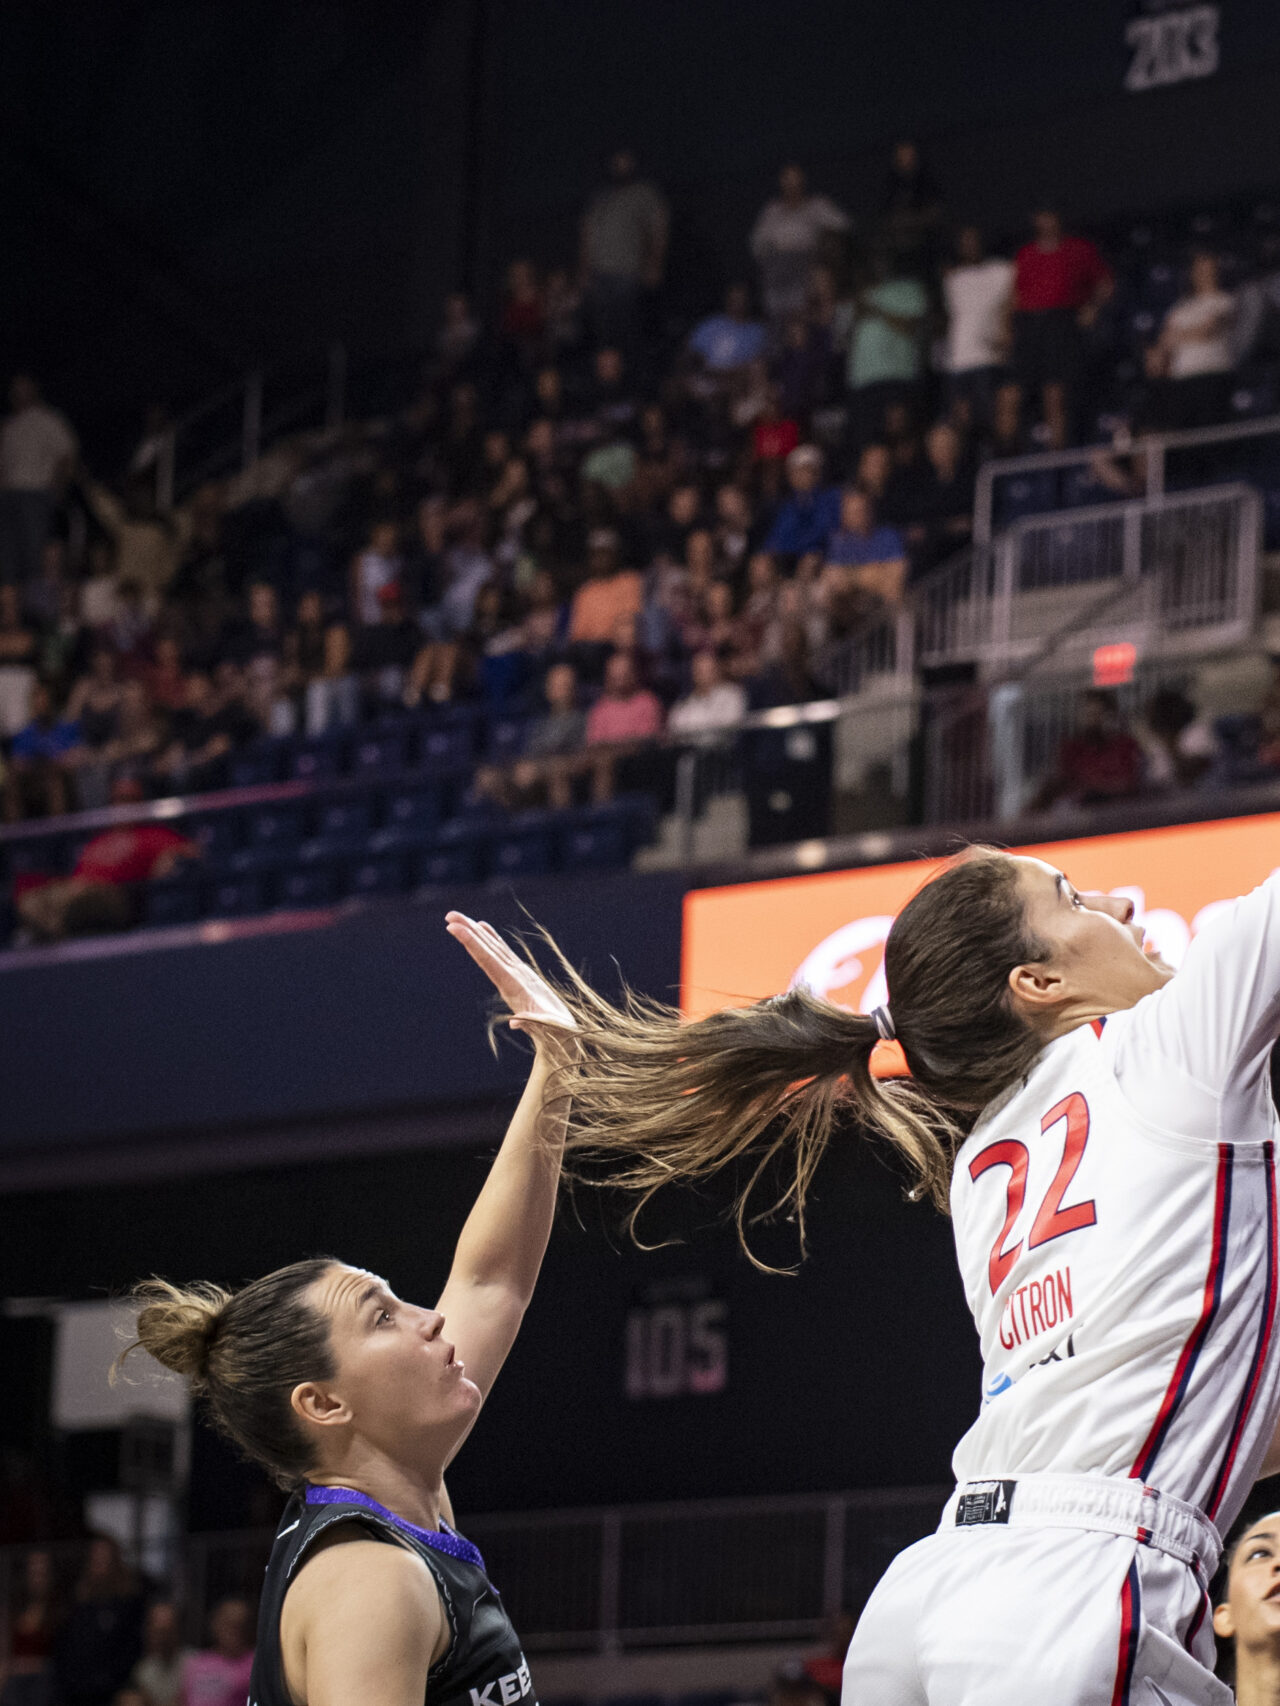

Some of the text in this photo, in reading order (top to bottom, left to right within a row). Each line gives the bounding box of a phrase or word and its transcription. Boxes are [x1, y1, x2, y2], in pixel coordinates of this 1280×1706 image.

[1124, 5, 1220, 91] 203
[968, 1091, 1097, 1296] 22
[625, 1299, 727, 1399] 105
[1000, 1266, 1073, 1351] CITRON
